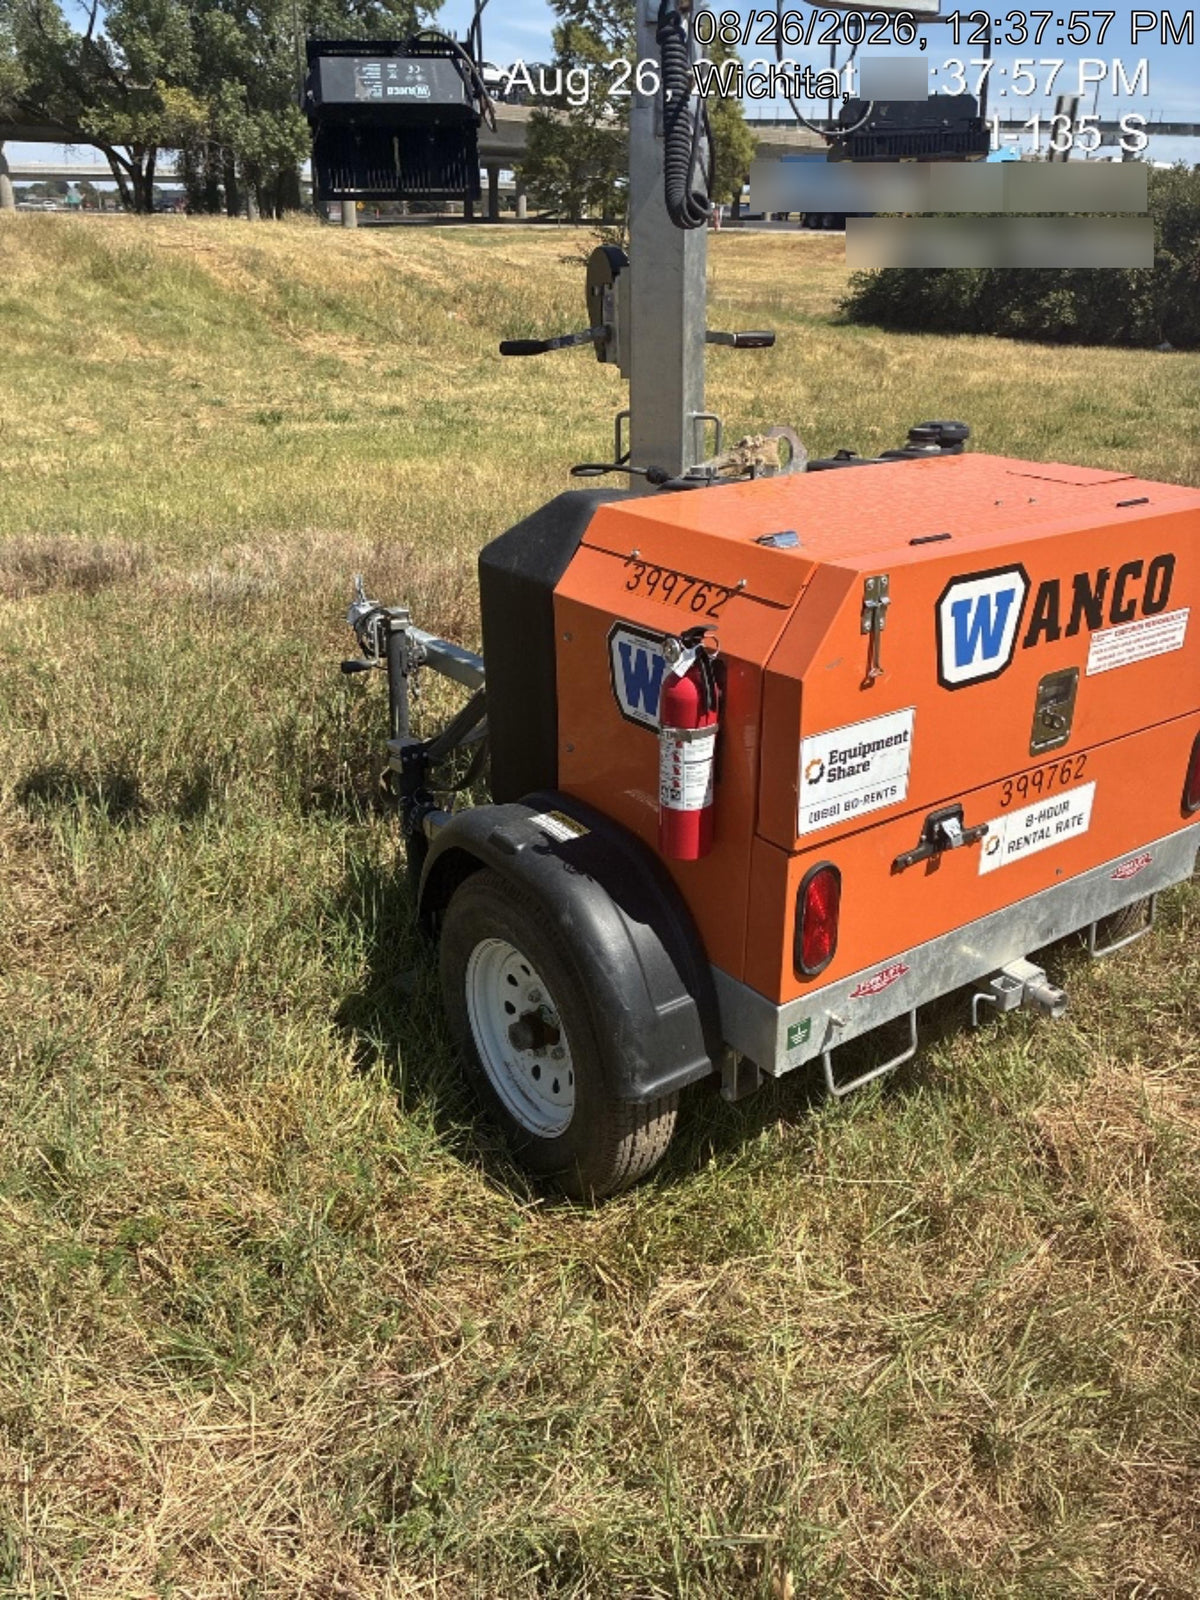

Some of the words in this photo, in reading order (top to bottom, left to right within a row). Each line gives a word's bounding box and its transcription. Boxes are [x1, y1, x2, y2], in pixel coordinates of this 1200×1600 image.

[626, 561, 730, 619] 399762
[950, 553, 1176, 668] WANCO
[618, 641, 666, 717] W
[828, 729, 909, 765] Equipment
[827, 760, 871, 783] Share
[1000, 753, 1087, 807] 399762
[1007, 826, 1051, 854] RENTAL
[1055, 812, 1085, 835] RATE
[1025, 800, 1070, 828] 8-HOUR
